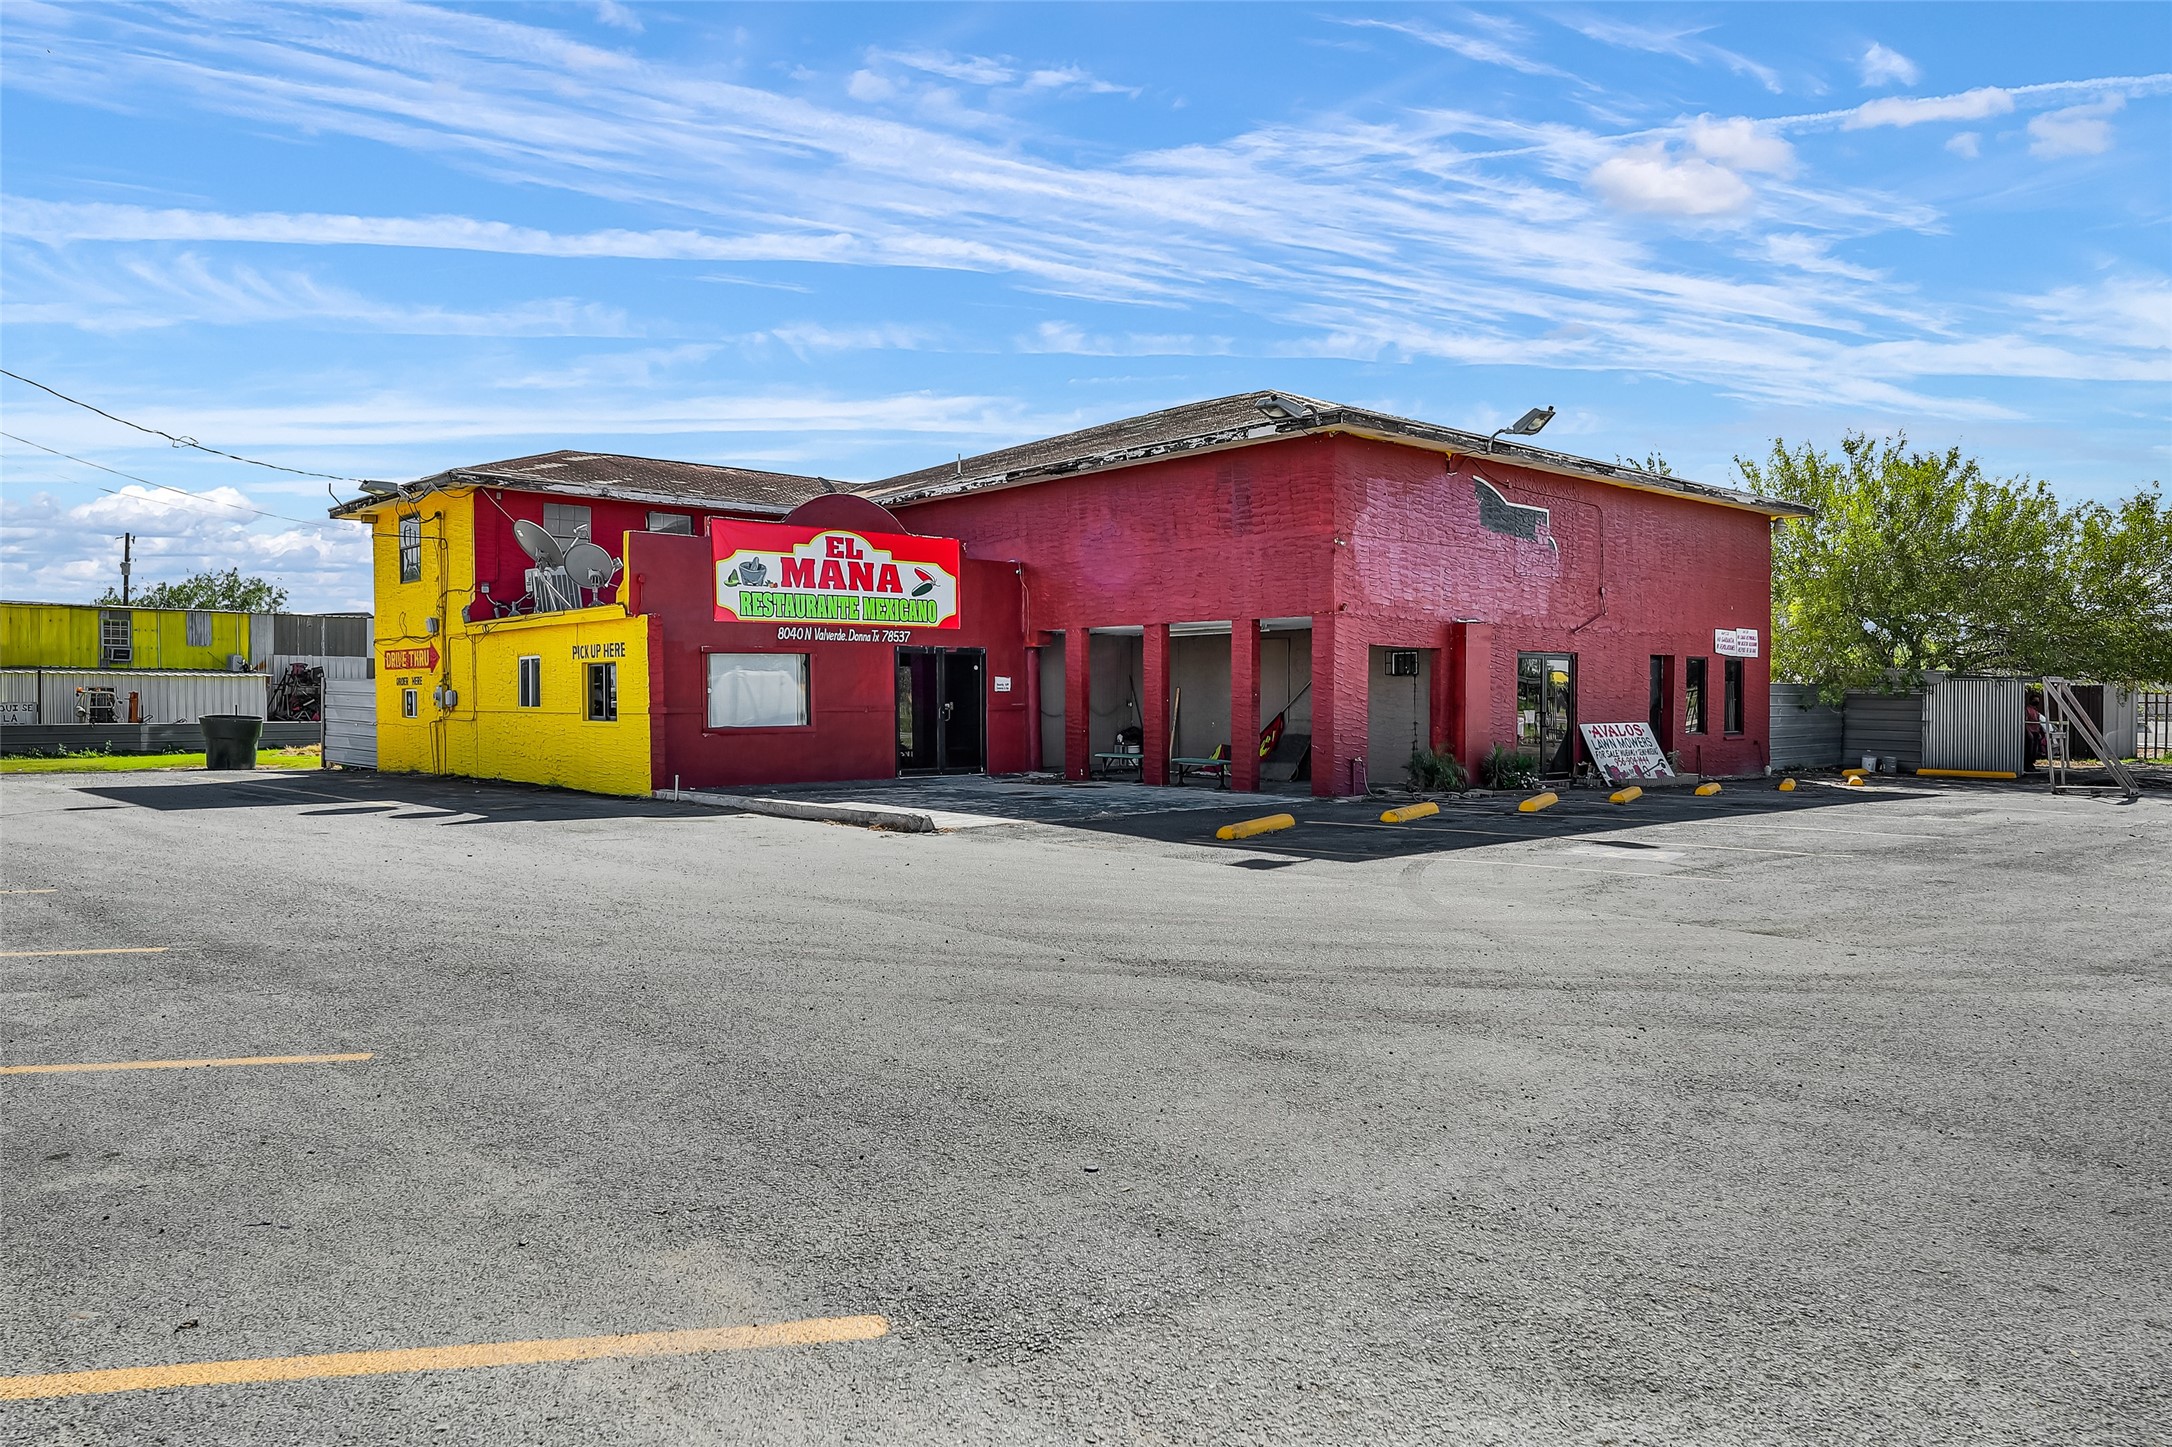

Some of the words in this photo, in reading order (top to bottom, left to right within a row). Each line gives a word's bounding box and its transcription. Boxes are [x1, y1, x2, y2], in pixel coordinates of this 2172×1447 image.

[825, 535, 864, 560] EL
[780, 556, 904, 594] MANA
[739, 591, 860, 620] RESTAURANTE
[863, 596, 938, 624] MEXICANO
[777, 626, 804, 640] 8040
[804, 626, 812, 641] N
[871, 629, 880, 642] Tx
[881, 630, 911, 643] 78537
[386, 651, 407, 668] DRIVE
[408, 649, 430, 667] THRU
[572, 644, 589, 659] PICK
[590, 643, 601, 659] UP
[603, 642, 626, 657] HERE
[411, 676, 422, 685] HERE
[22, 704, 33, 712] SE
[3, 714, 18, 722] LA
[1591, 738, 1617, 750] LAWN
[1617, 737, 1653, 749] MOWERS
